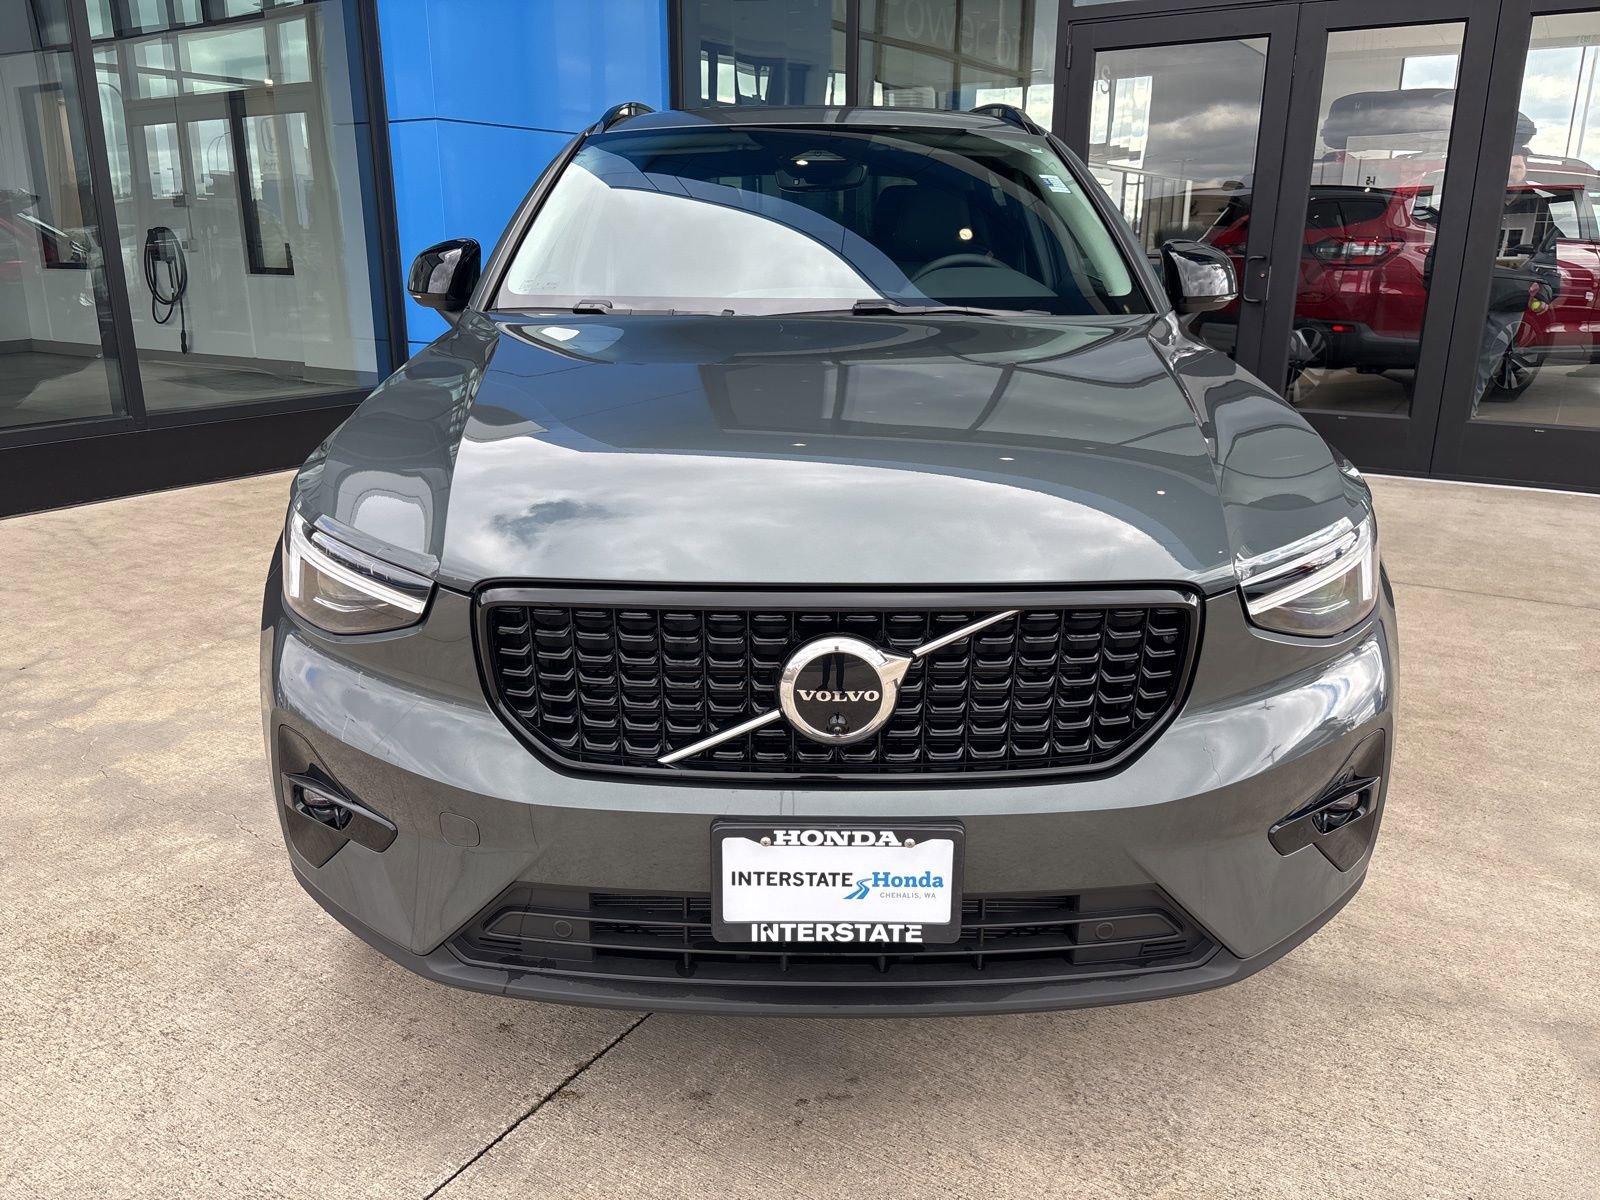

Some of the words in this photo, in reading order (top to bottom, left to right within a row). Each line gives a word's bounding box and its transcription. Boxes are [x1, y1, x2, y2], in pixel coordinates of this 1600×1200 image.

[797, 689, 880, 702] VOLVO
[773, 829, 903, 847] HONDA
[731, 871, 853, 887] INTERSTATE
[872, 870, 944, 888] Honda
[879, 892, 922, 900] CHEHALIS,
[751, 923, 923, 943] INTERSTATE
